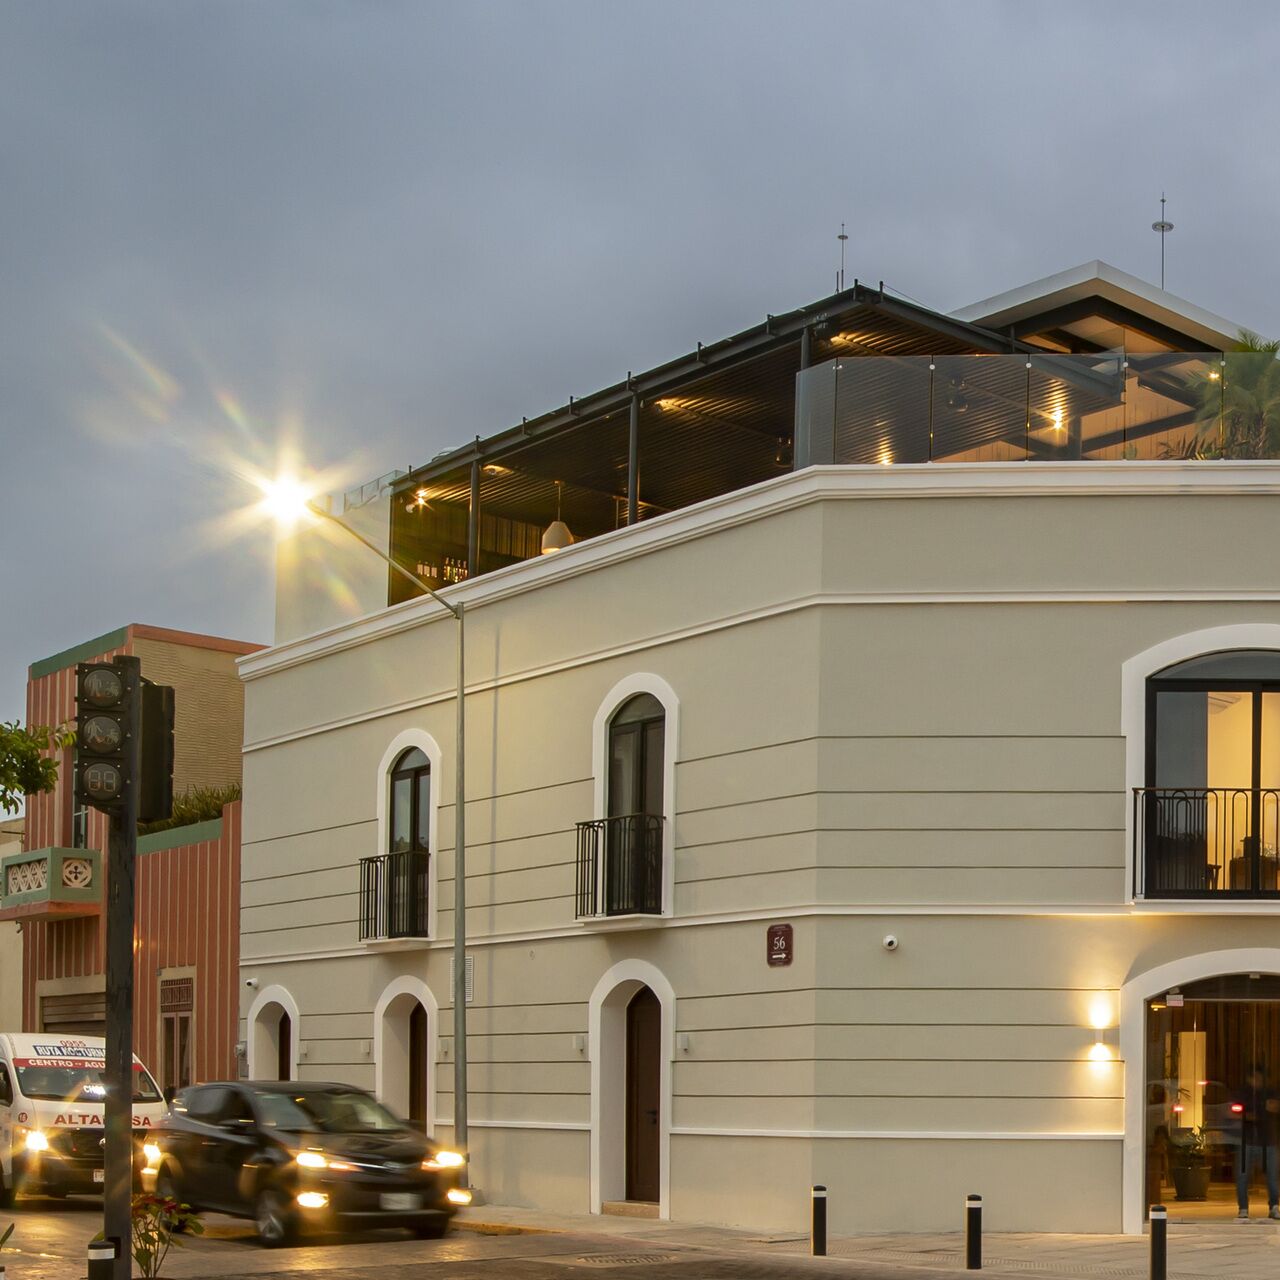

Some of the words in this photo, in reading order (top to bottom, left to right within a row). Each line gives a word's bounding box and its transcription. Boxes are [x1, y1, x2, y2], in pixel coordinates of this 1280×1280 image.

[773, 936, 786, 950] 56
[36, 1046, 62, 1056] RUTA
[28, 1059, 73, 1067] CENTRO
[84, 1061, 105, 1069] AGU
[54, 1115, 152, 1127] ALTASA
